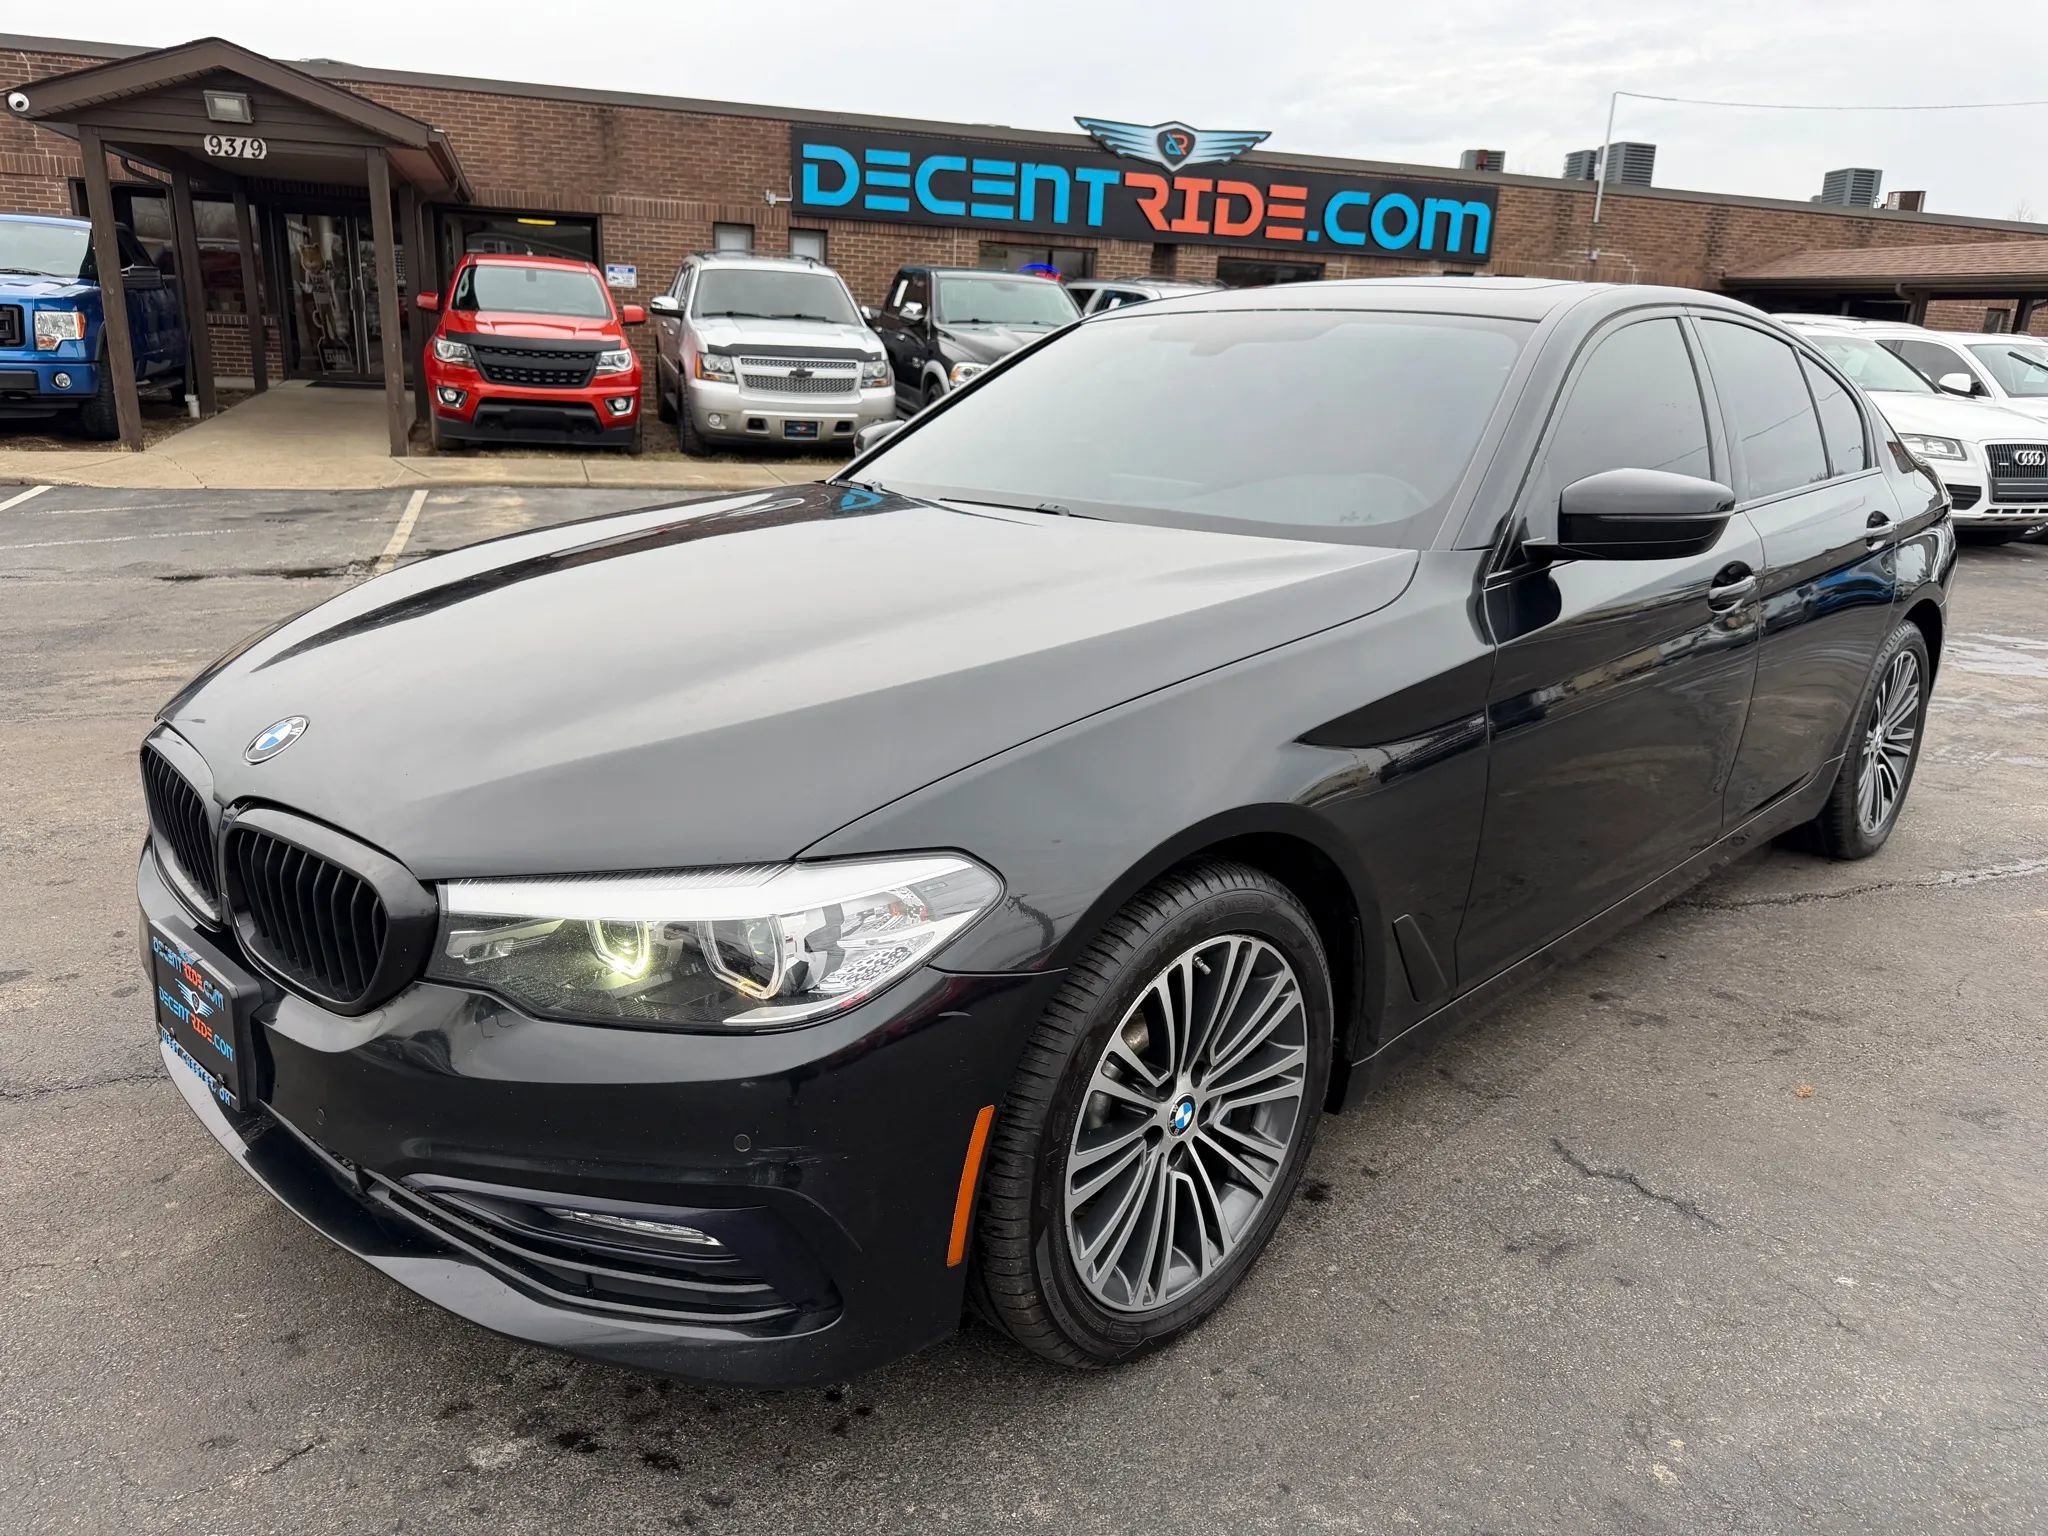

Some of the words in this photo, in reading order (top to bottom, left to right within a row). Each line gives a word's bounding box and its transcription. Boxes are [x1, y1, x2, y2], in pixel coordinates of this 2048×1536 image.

[209, 135, 263, 158] 9319
[803, 143, 1491, 255] DECENTRIDE.COM
[159, 986, 234, 1062] DECENTRIDE.COM
